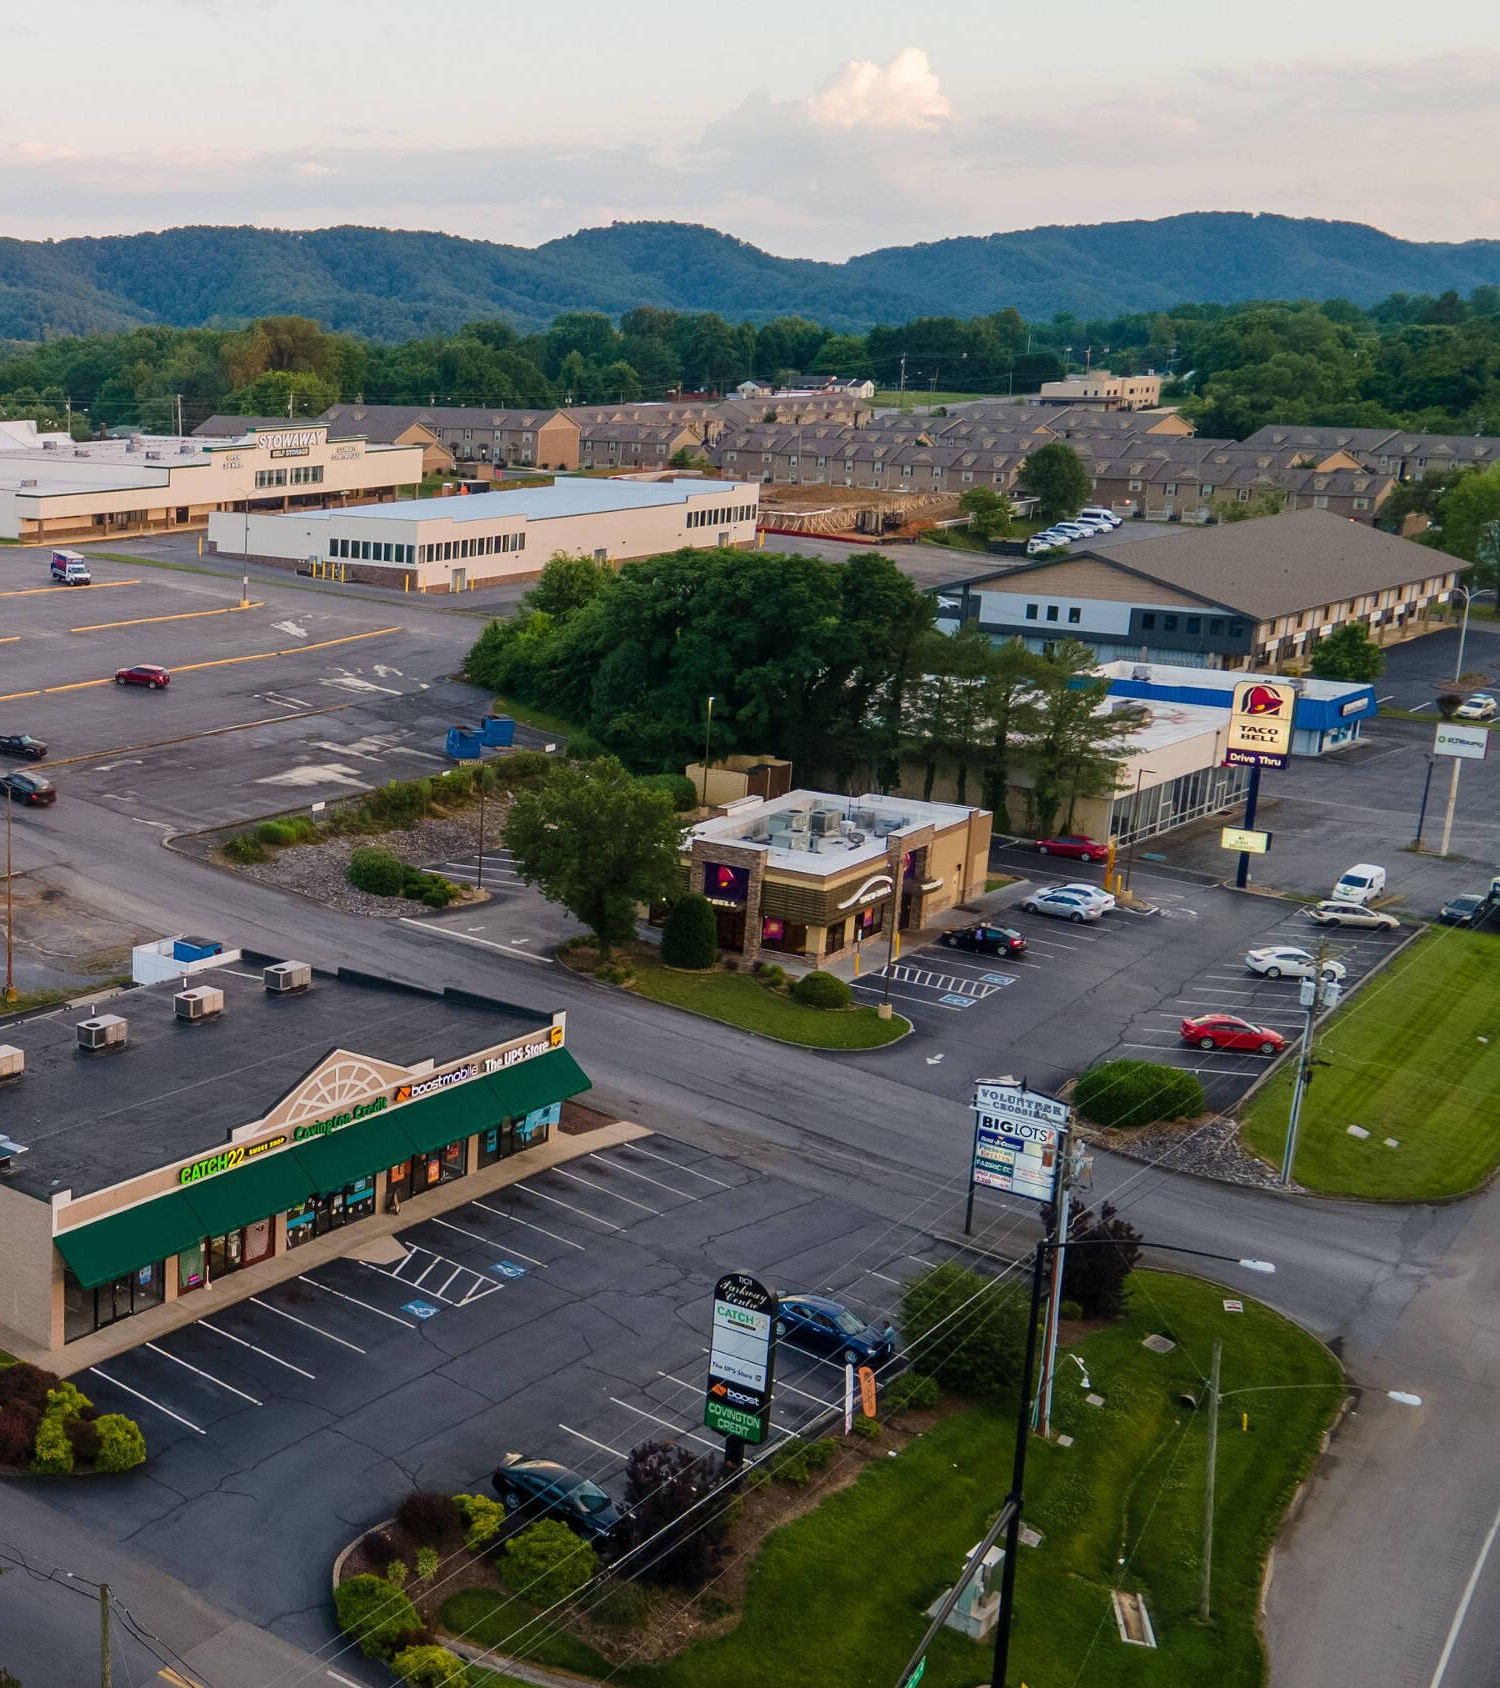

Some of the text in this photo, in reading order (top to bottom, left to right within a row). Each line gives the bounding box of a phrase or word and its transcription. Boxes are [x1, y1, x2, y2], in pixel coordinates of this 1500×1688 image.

[258, 432, 324, 449] STOWAWAY
[272, 448, 309, 458] SELF STORAGE
[1240, 725, 1278, 735] TACO
[1241, 733, 1279, 743] BELL
[1230, 753, 1281, 766] Drive Thru
[484, 1040, 549, 1073] The UPS Store
[294, 1096, 387, 1141] Covington Credit
[269, 1137, 285, 1149] SHOP
[720, 1280, 768, 1304] Parkway
[727, 1387, 760, 1407] boost
[708, 1401, 760, 1429] COVINGTON
[717, 1417, 750, 1437] CREDIT
